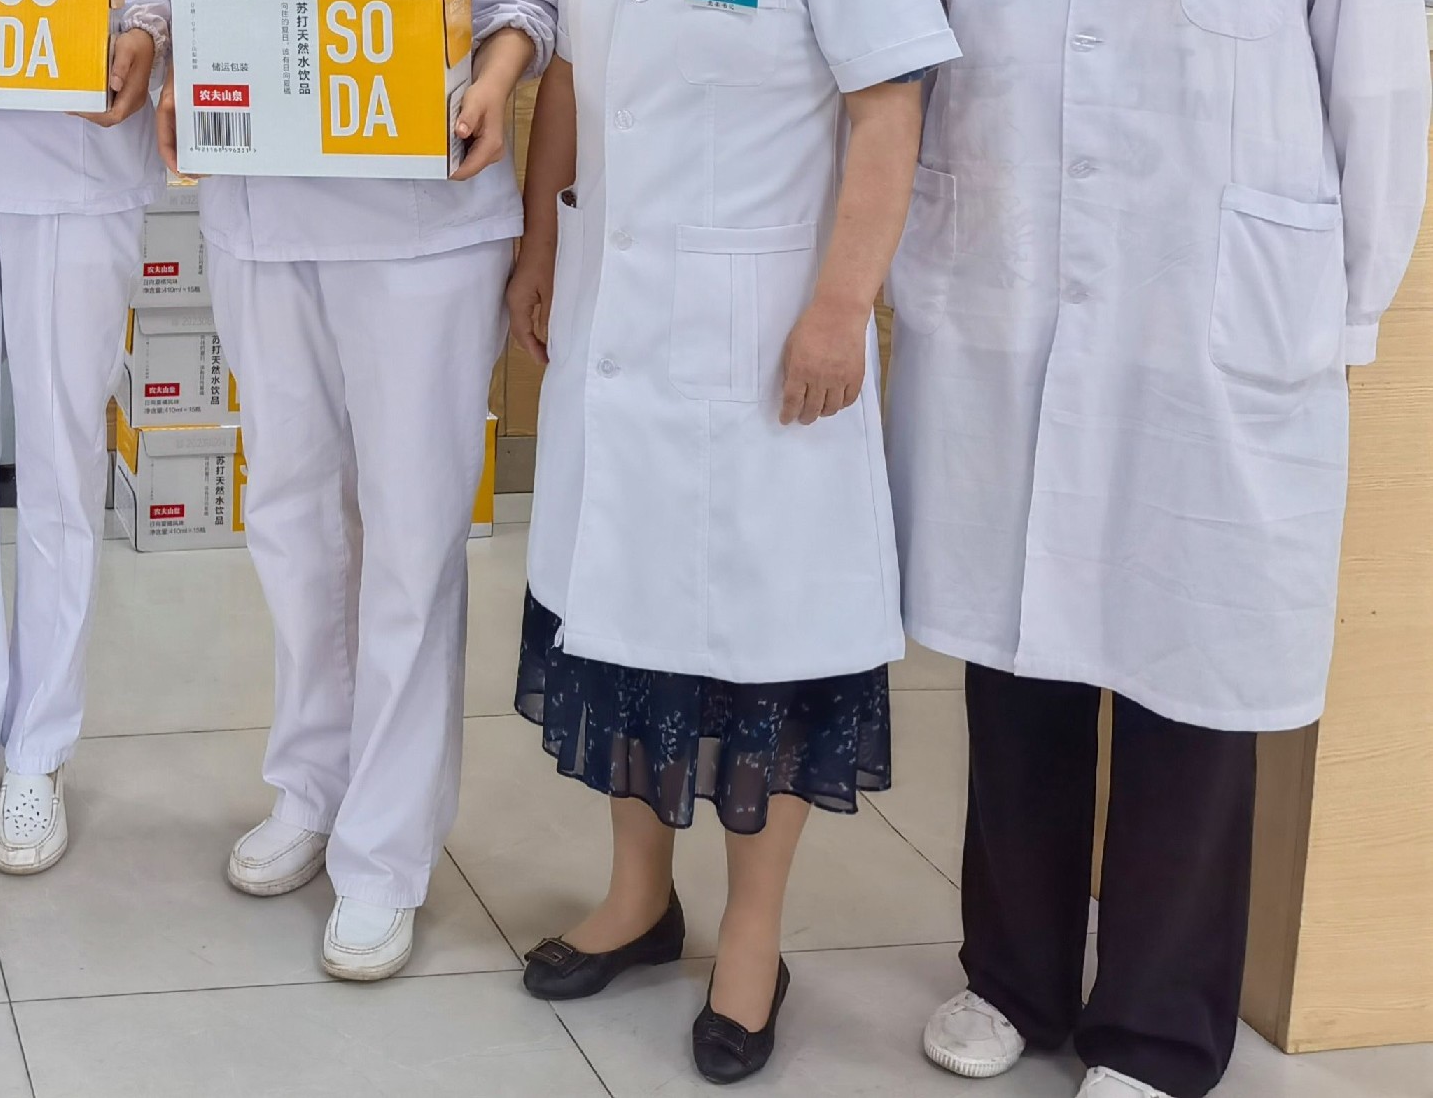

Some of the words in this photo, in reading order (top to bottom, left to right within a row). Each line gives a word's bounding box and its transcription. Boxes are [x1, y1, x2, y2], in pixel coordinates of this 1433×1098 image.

[296, 2, 311, 95] 苏打天然水饮品
[326, 0, 394, 63] SO
[199, 89, 243, 102] 农夫山泉
[212, 62, 249, 72] 储运包装
[329, 75, 398, 137] DA
[215, 456, 225, 526] 苏打天然水饮品
